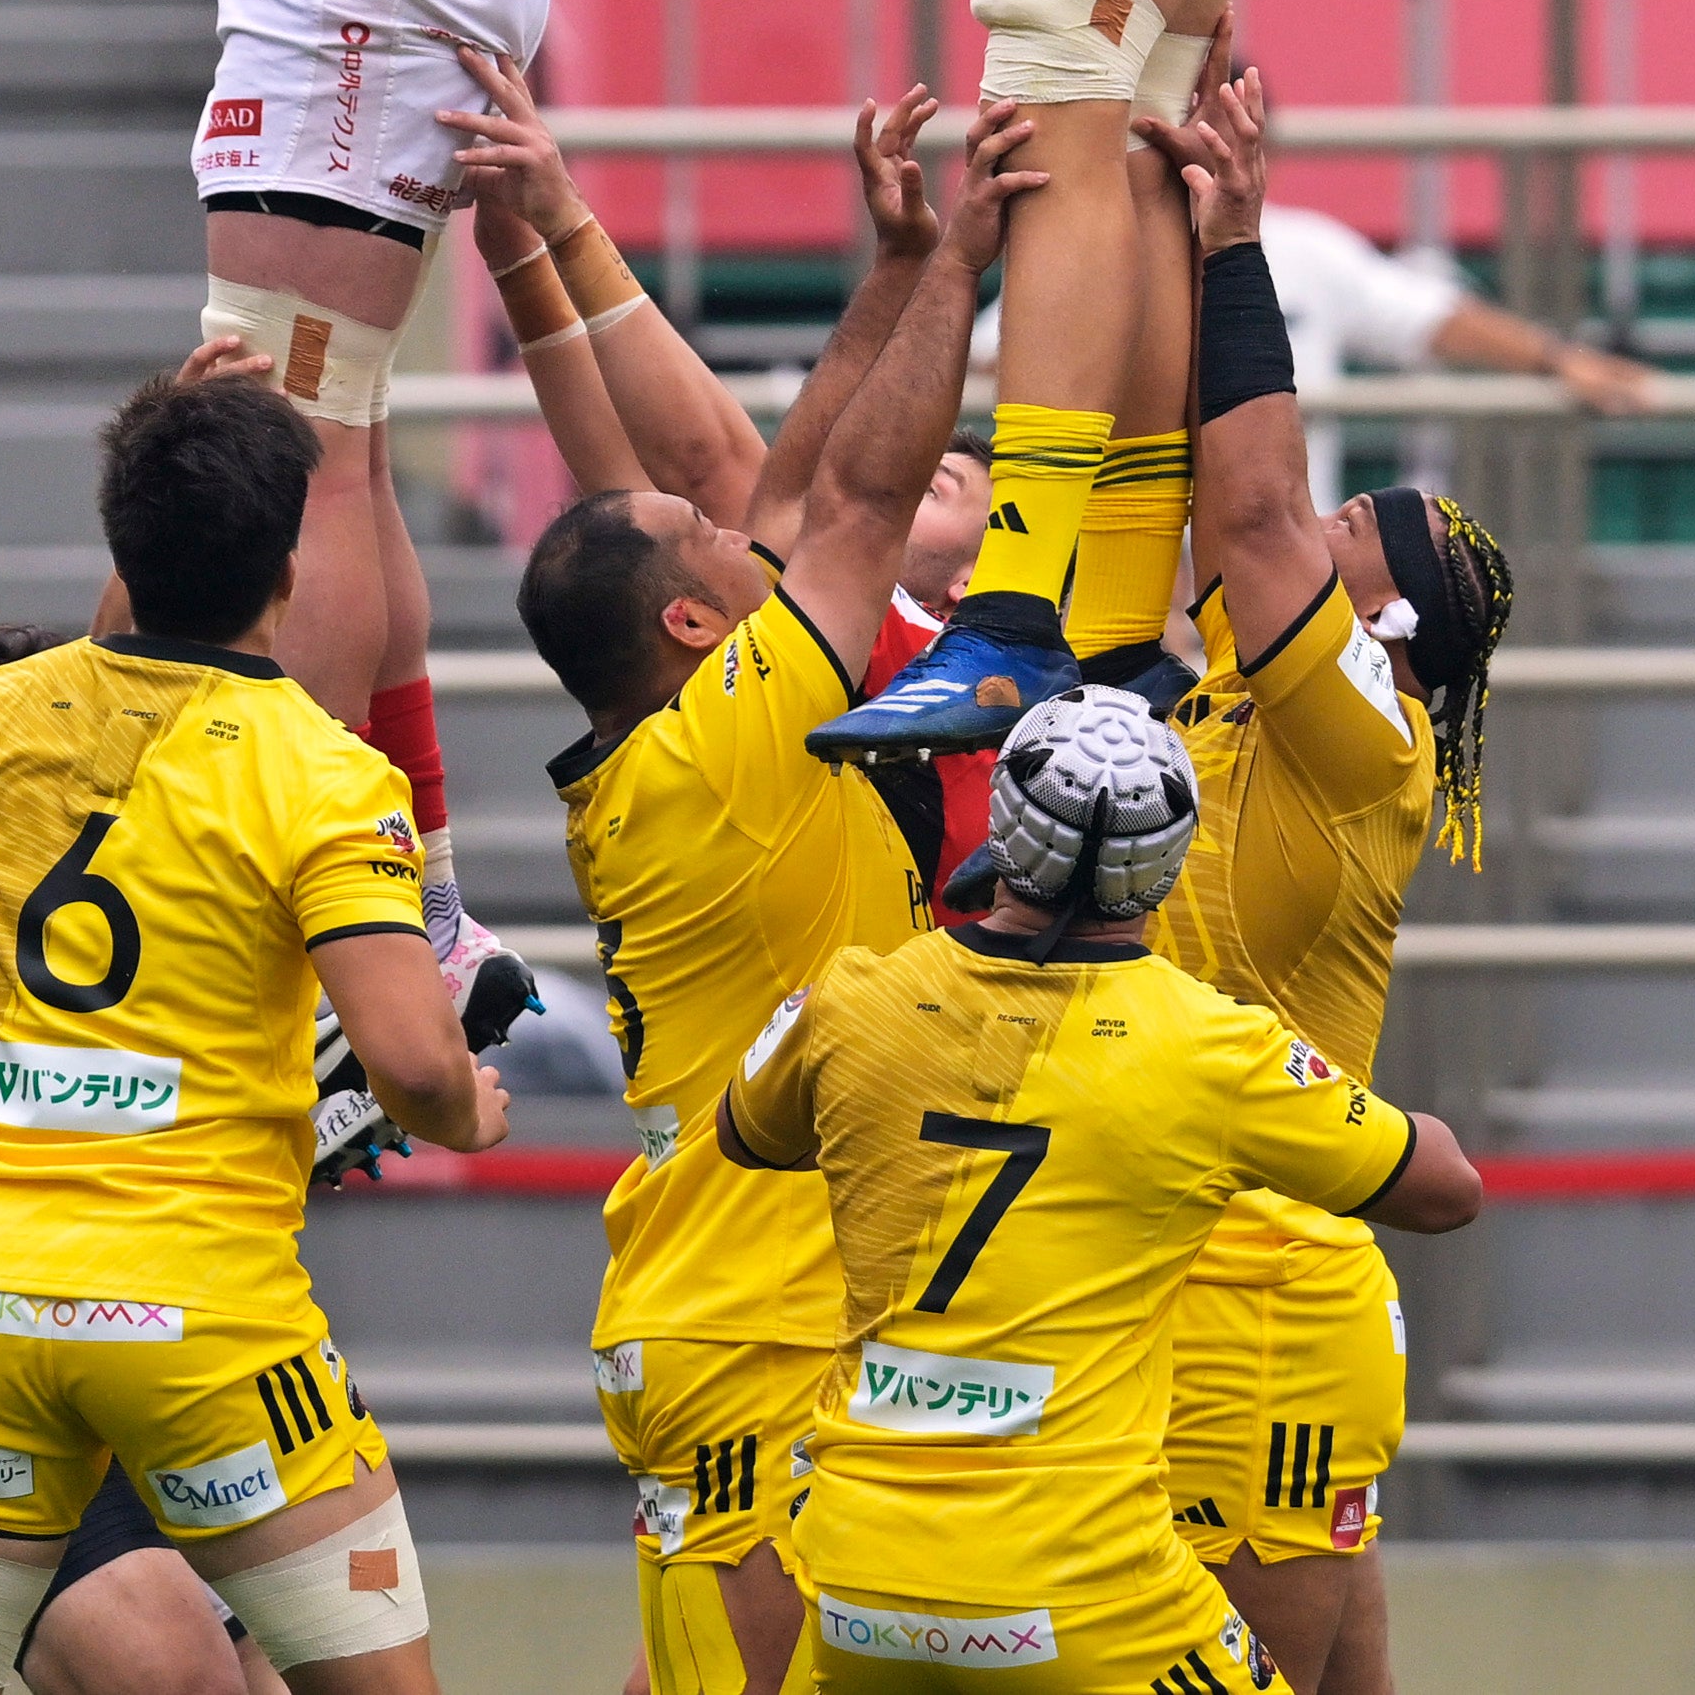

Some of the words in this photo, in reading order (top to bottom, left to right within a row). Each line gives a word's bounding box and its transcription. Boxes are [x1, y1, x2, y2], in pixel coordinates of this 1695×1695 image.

[328, 51, 364, 173] 中外テクノス
[205, 727, 226, 739] GIVE
[226, 732, 240, 742] UP
[210, 718, 241, 733] NEVER
[16, 811, 142, 1014] 6
[917, 1002, 942, 1013] PRIDE
[997, 1013, 1038, 1026] RESPECT
[1096, 1018, 1126, 1028] NEVER
[1091, 1028, 1113, 1038] GIVE
[1114, 1030, 1129, 1038] UP
[912, 1110, 1052, 1315] 7
[85, 1301, 169, 1328] MX
[155, 1467, 271, 1511] eMnet
[826, 1610, 949, 1654] TOKYO
[961, 1624, 1042, 1654] MX
